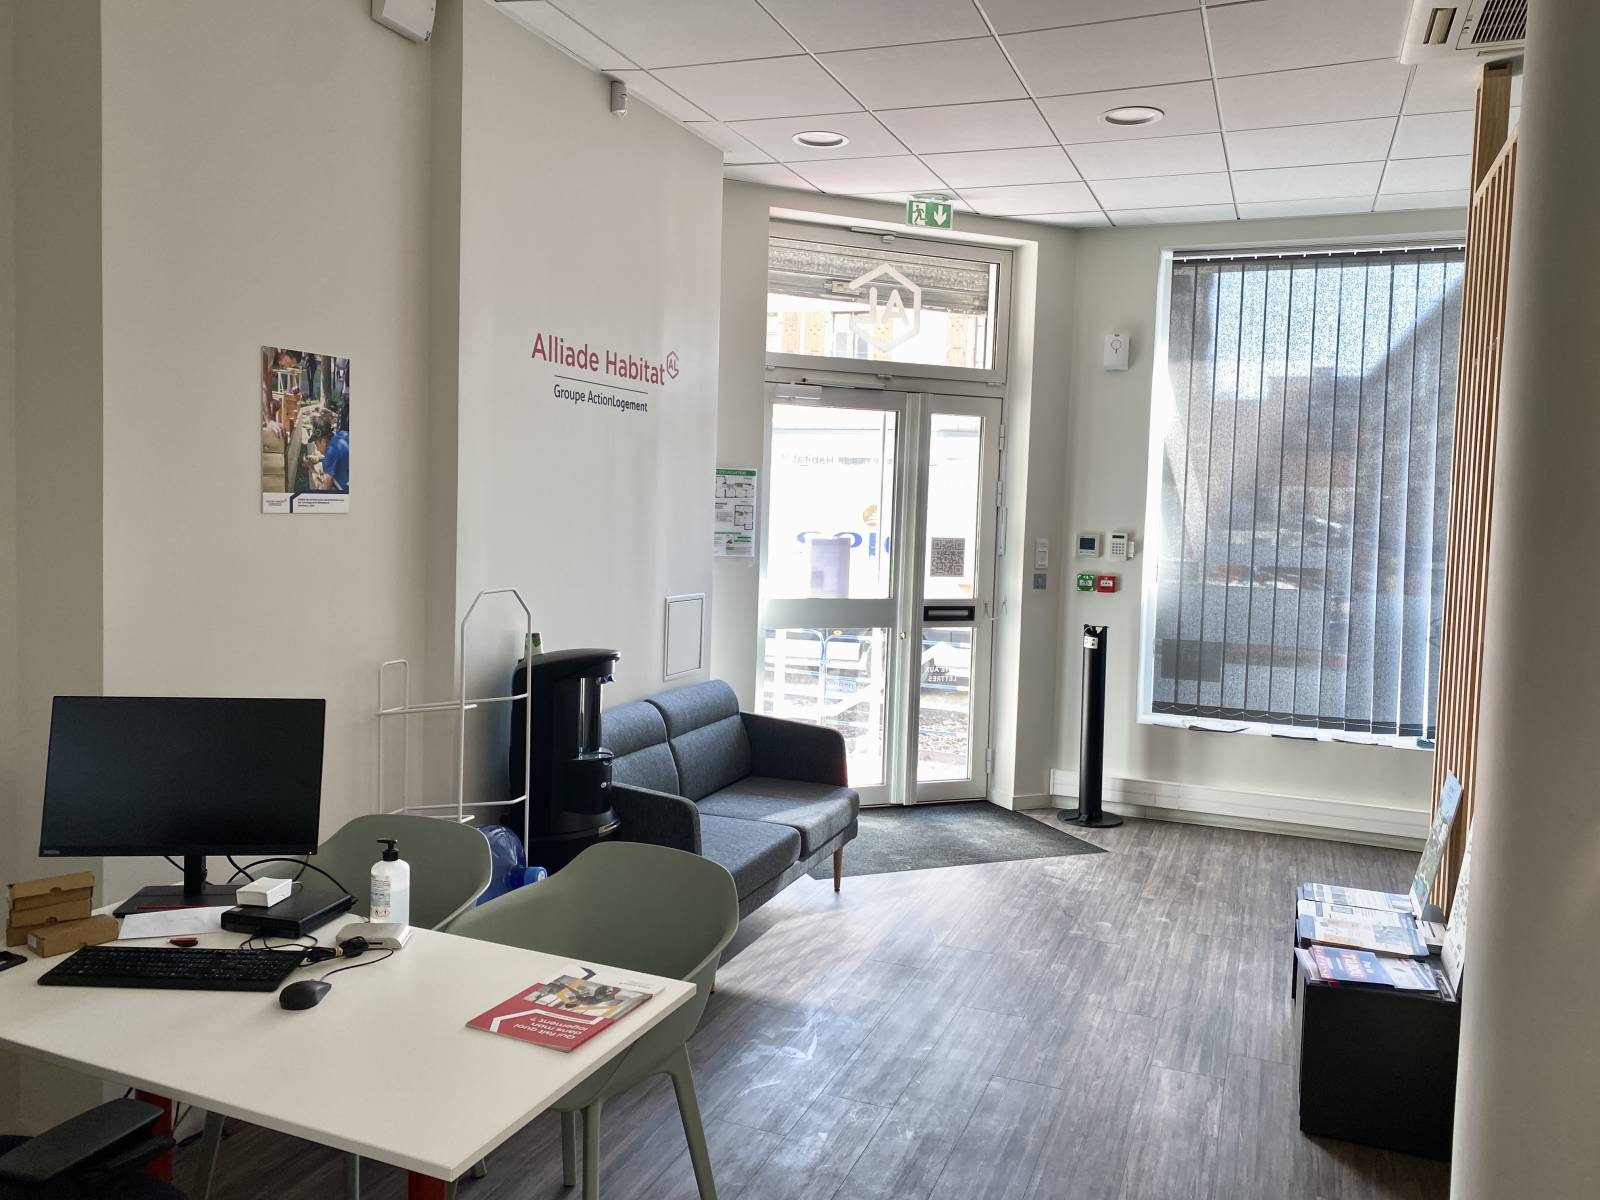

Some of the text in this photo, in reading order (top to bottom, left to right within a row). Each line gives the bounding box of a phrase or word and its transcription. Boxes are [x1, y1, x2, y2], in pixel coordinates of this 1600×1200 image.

[531, 333, 665, 385] Alliade Habitat
[553, 384, 648, 412] Groupe ActionLogement
